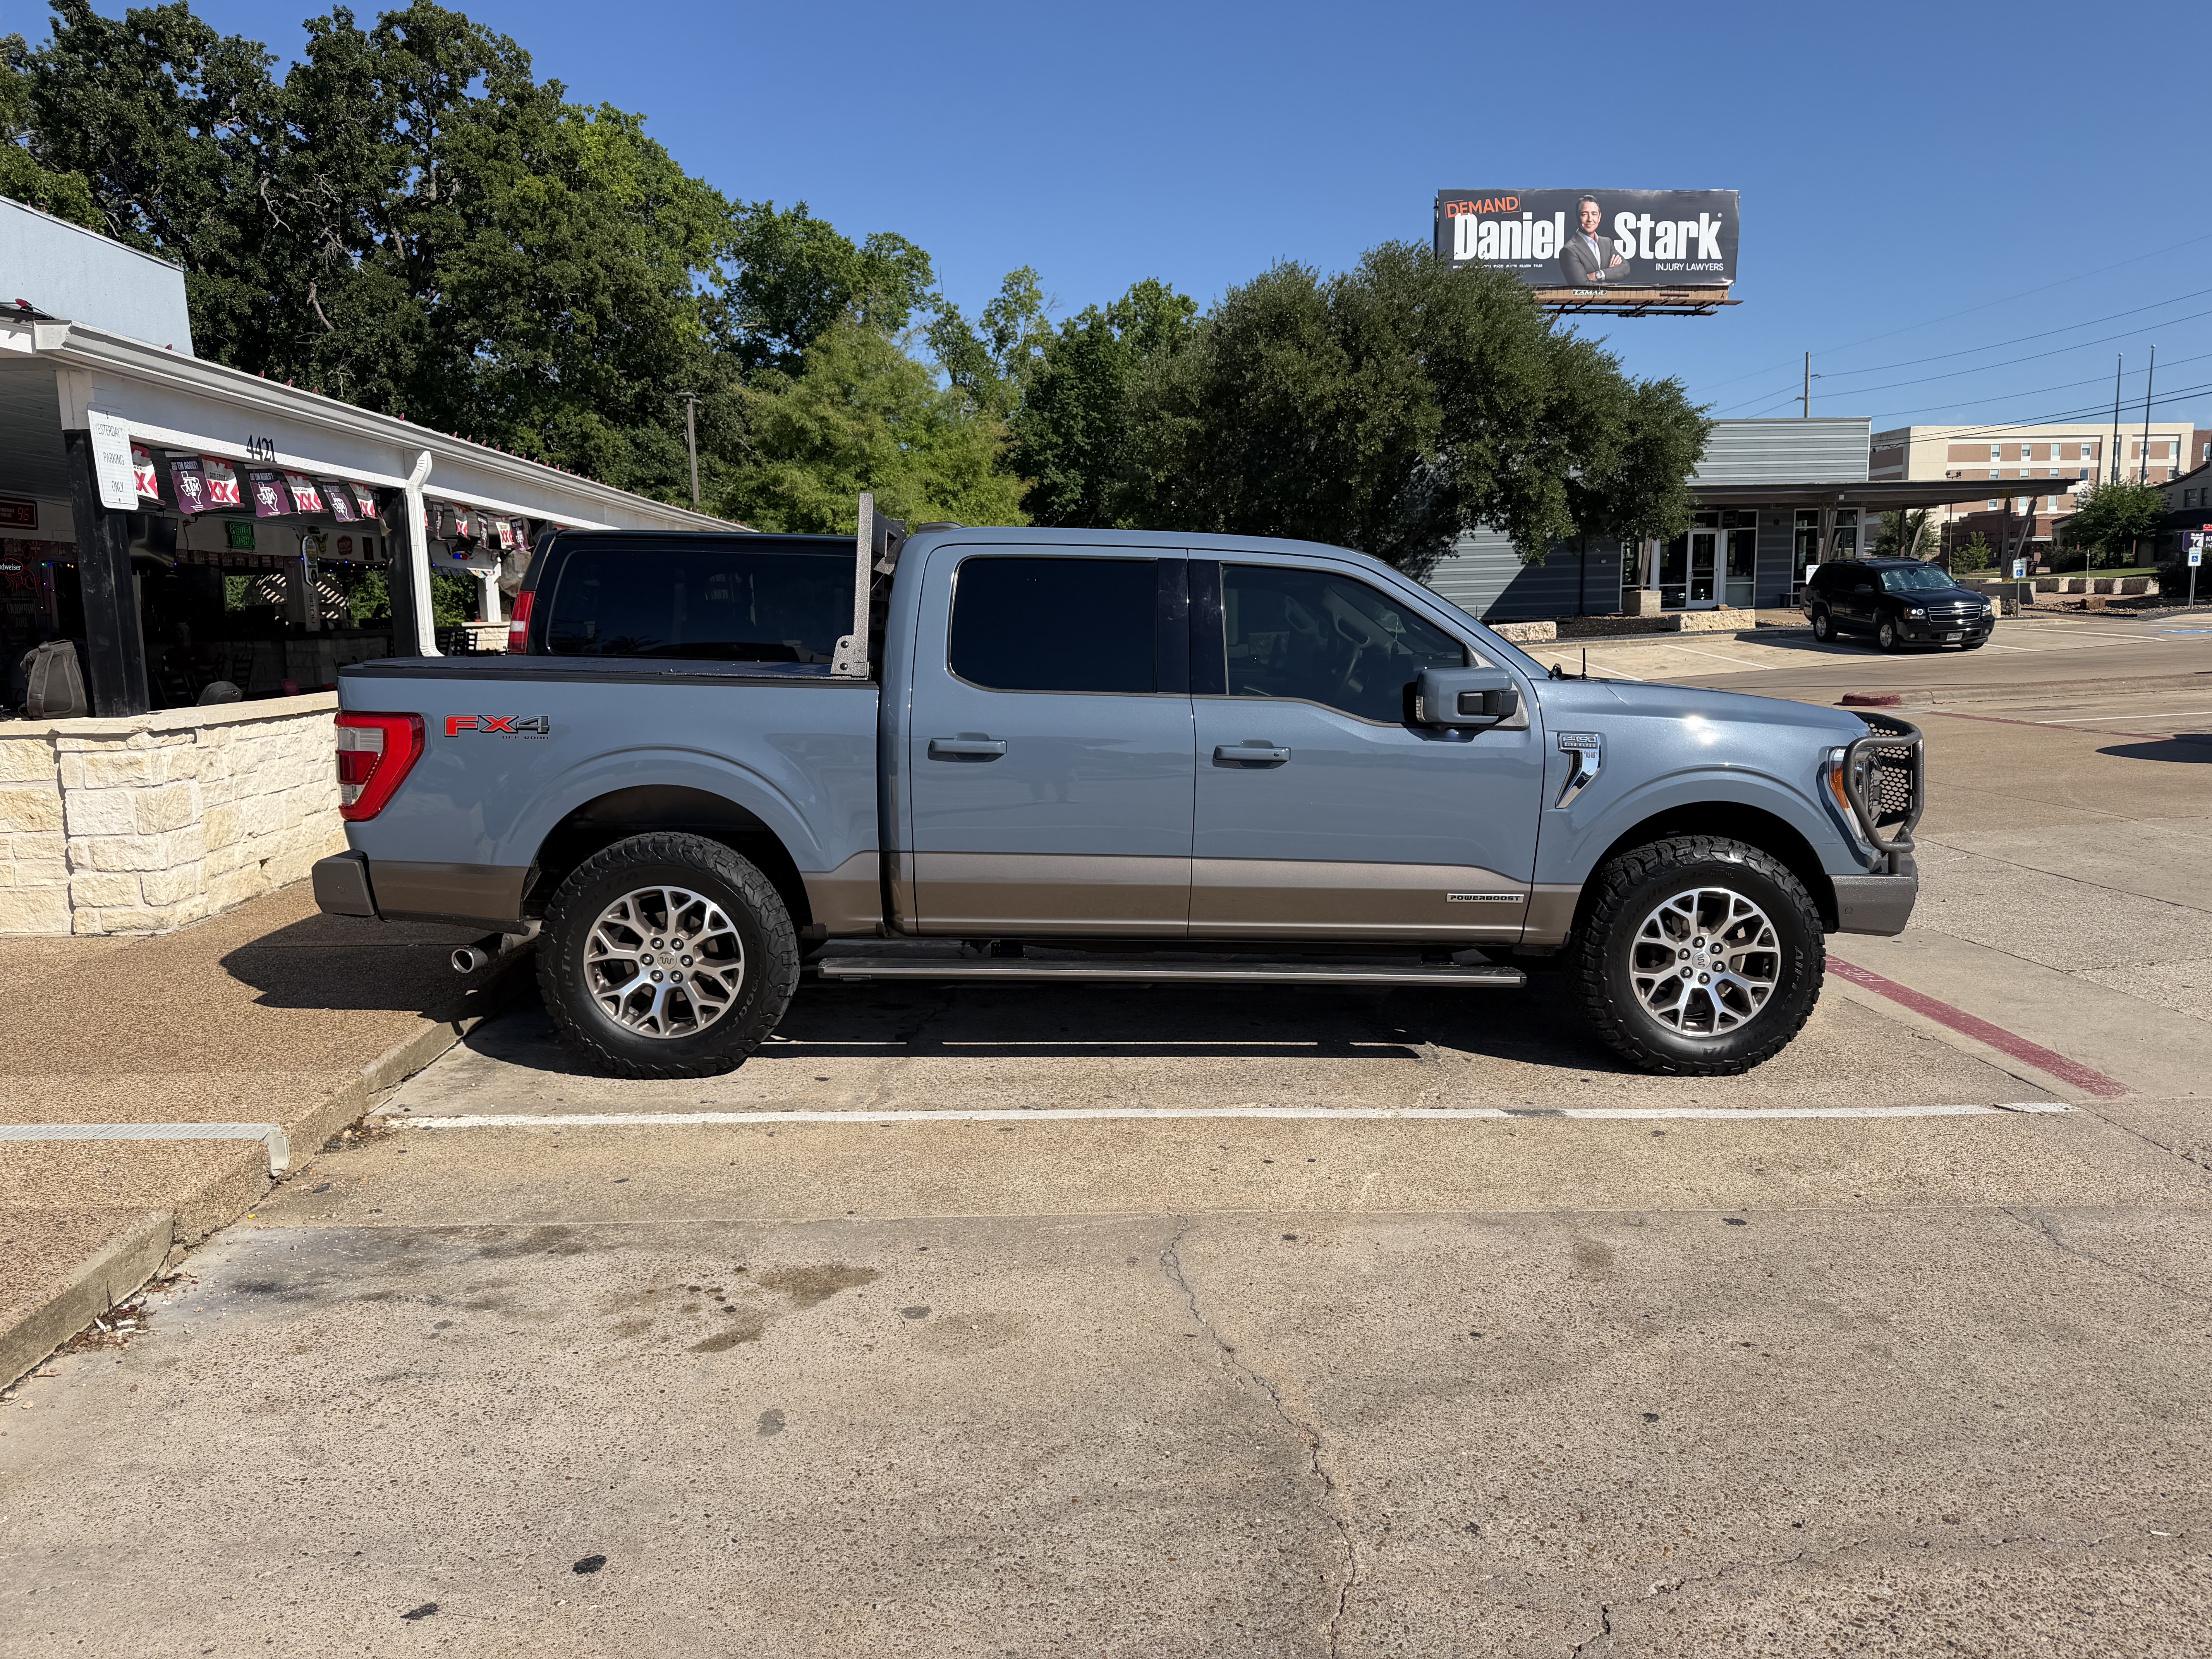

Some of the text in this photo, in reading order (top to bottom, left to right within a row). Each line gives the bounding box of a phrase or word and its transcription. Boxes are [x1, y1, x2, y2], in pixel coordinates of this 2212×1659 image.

[1447, 196, 1518, 218] DEMAND
[1454, 211, 1723, 260] Daniel Stark
[1656, 263, 1724, 271] INJURY LAWYERS
[94, 423, 125, 438] YESTERDAY'S
[246, 434, 277, 463] 4421
[103, 452, 124, 465] PARKING
[112, 481, 124, 493] ONLY
[236, 526, 249, 536] BUD
[233, 535, 253, 546] LIGHT
[444, 714, 550, 737] FX4
